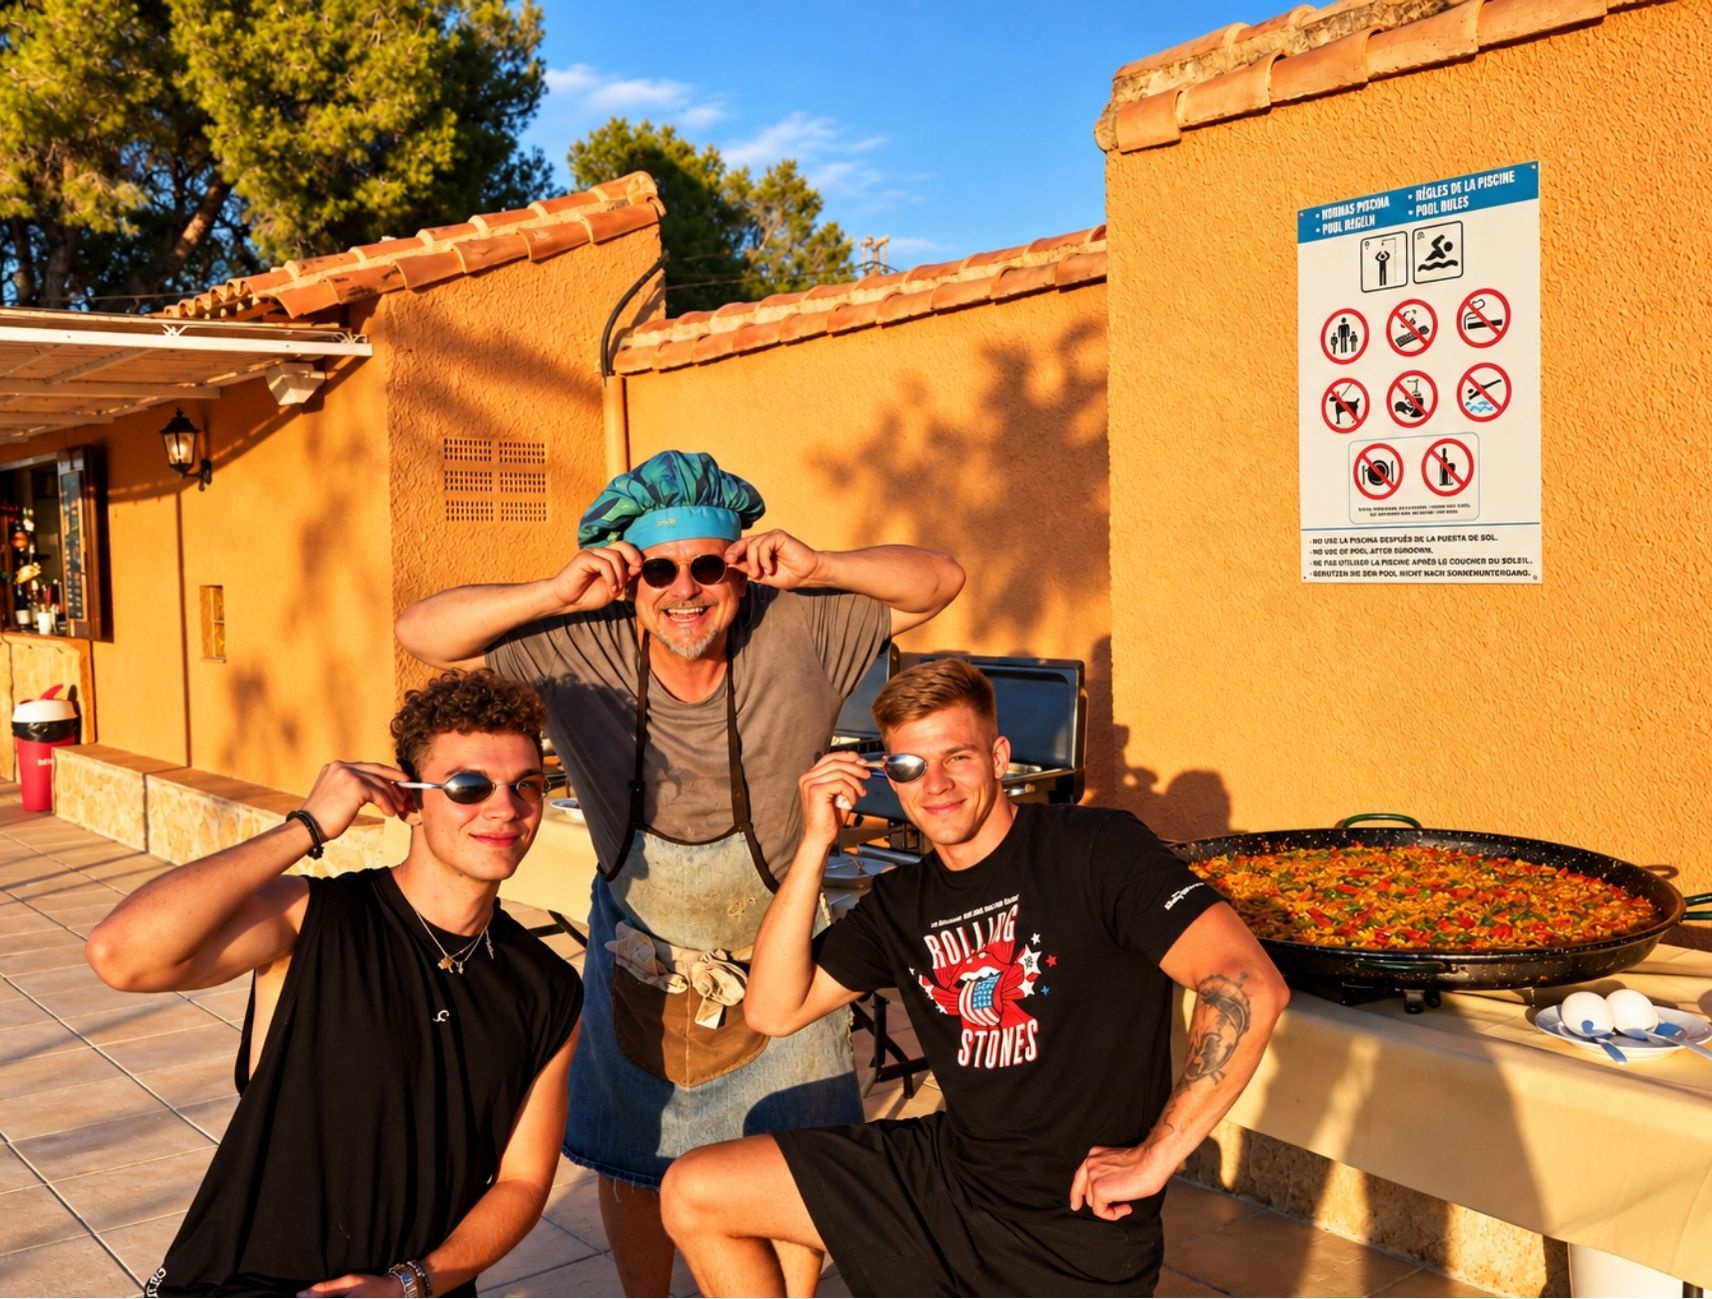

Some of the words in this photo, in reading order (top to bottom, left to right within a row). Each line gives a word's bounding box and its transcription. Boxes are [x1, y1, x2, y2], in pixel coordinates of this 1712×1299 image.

[1451, 181, 1462, 195] DE
[1464, 178, 1477, 192] LA
[1416, 202, 1439, 217] POOL
[957, 1018, 1040, 1070] STONES
